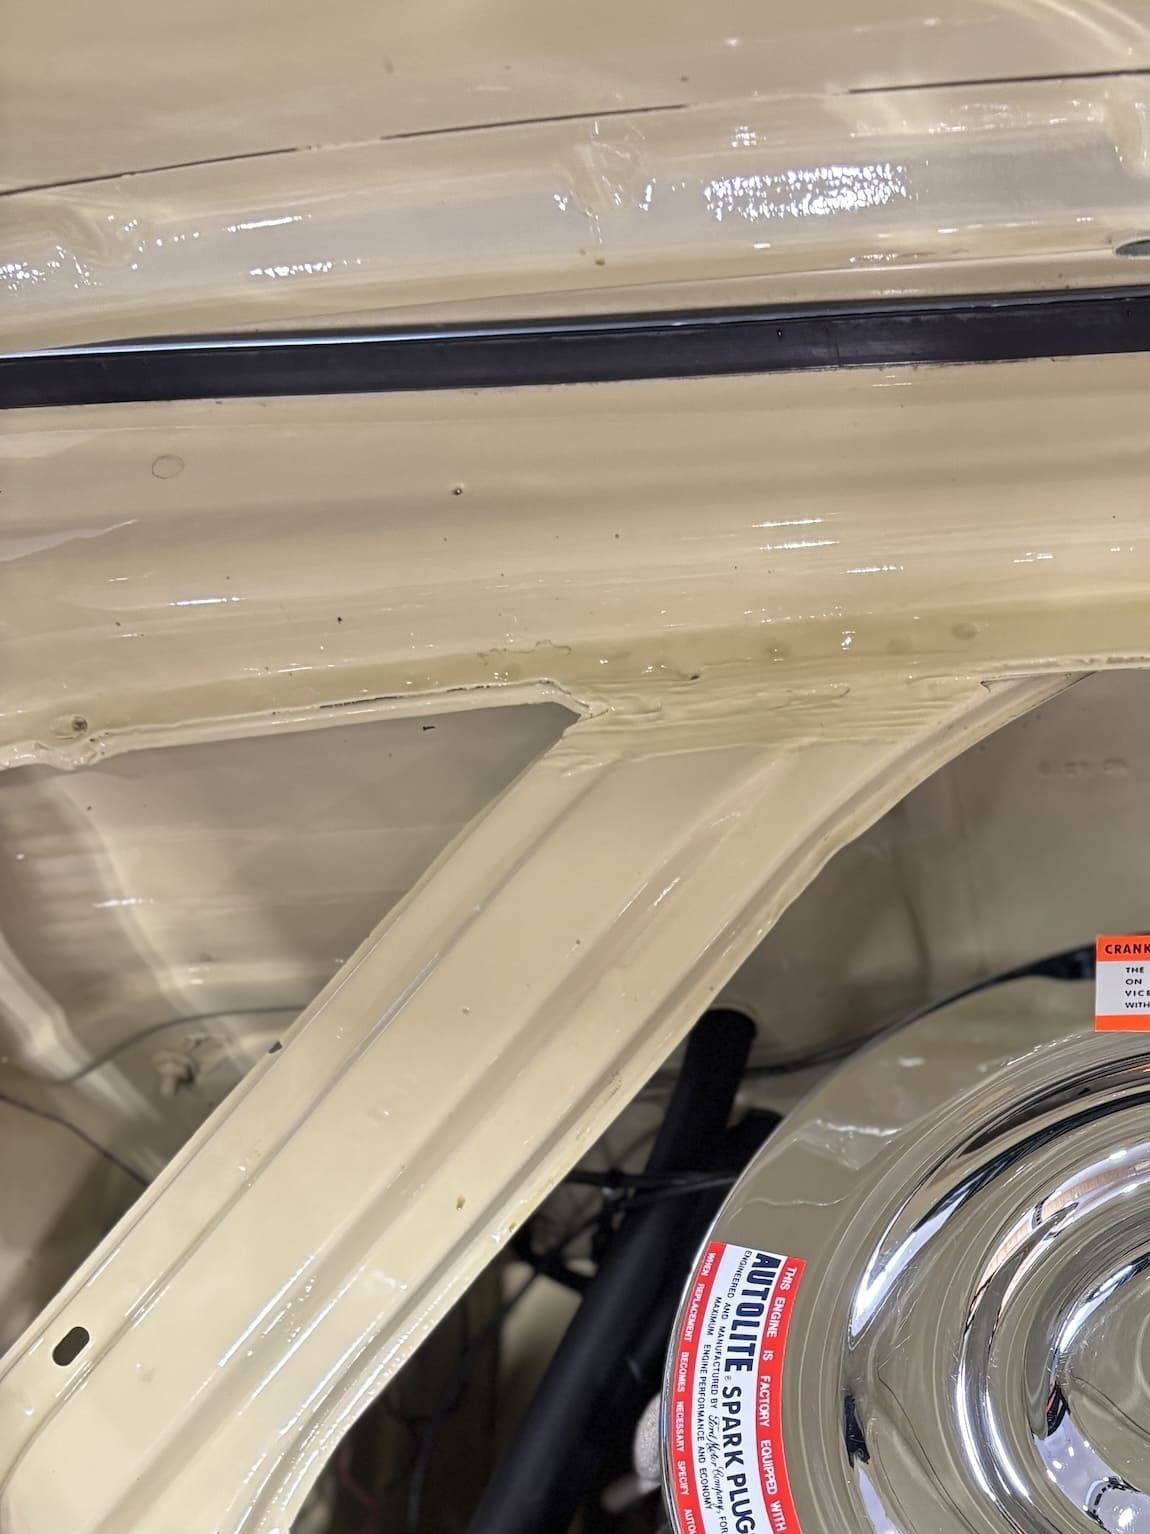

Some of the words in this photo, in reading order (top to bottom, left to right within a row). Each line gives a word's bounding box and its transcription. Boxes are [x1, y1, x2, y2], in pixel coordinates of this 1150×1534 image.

[701, 1252, 716, 1276] WHEN
[726, 1250, 752, 1298] ENGINEERED
[780, 1266, 797, 1290] THIS
[684, 1283, 705, 1342] REPLACEMENT
[706, 1297, 722, 1336] MAXIMUM
[721, 1302, 731, 1320] AND
[725, 1253, 781, 1372] AUTOLITE
[767, 1297, 785, 1338] ENGINE
[677, 1352, 689, 1392] BECOMES
[700, 1344, 711, 1374] ENGINE
[711, 1326, 726, 1396] MANUFACTURED
[763, 1350, 773, 1361] IS
[697, 1377, 706, 1442] PERFORMANCE
[710, 1398, 718, 1409] BY
[759, 1375, 770, 1427] FACTORY
[675, 1401, 685, 1452] NECESSARY
[707, 1415, 720, 1439] Ford
[722, 1386, 745, 1468] SPARK
[697, 1446, 707, 1464] AND
[706, 1439, 724, 1467] Motor
[760, 1440, 778, 1495] EQUIPPED
[677, 1460, 689, 1496] SPECIFY
[699, 1467, 713, 1511] ECONOMY
[719, 1516, 729, 1534] FOR
[769, 1501, 787, 1532] WITH
